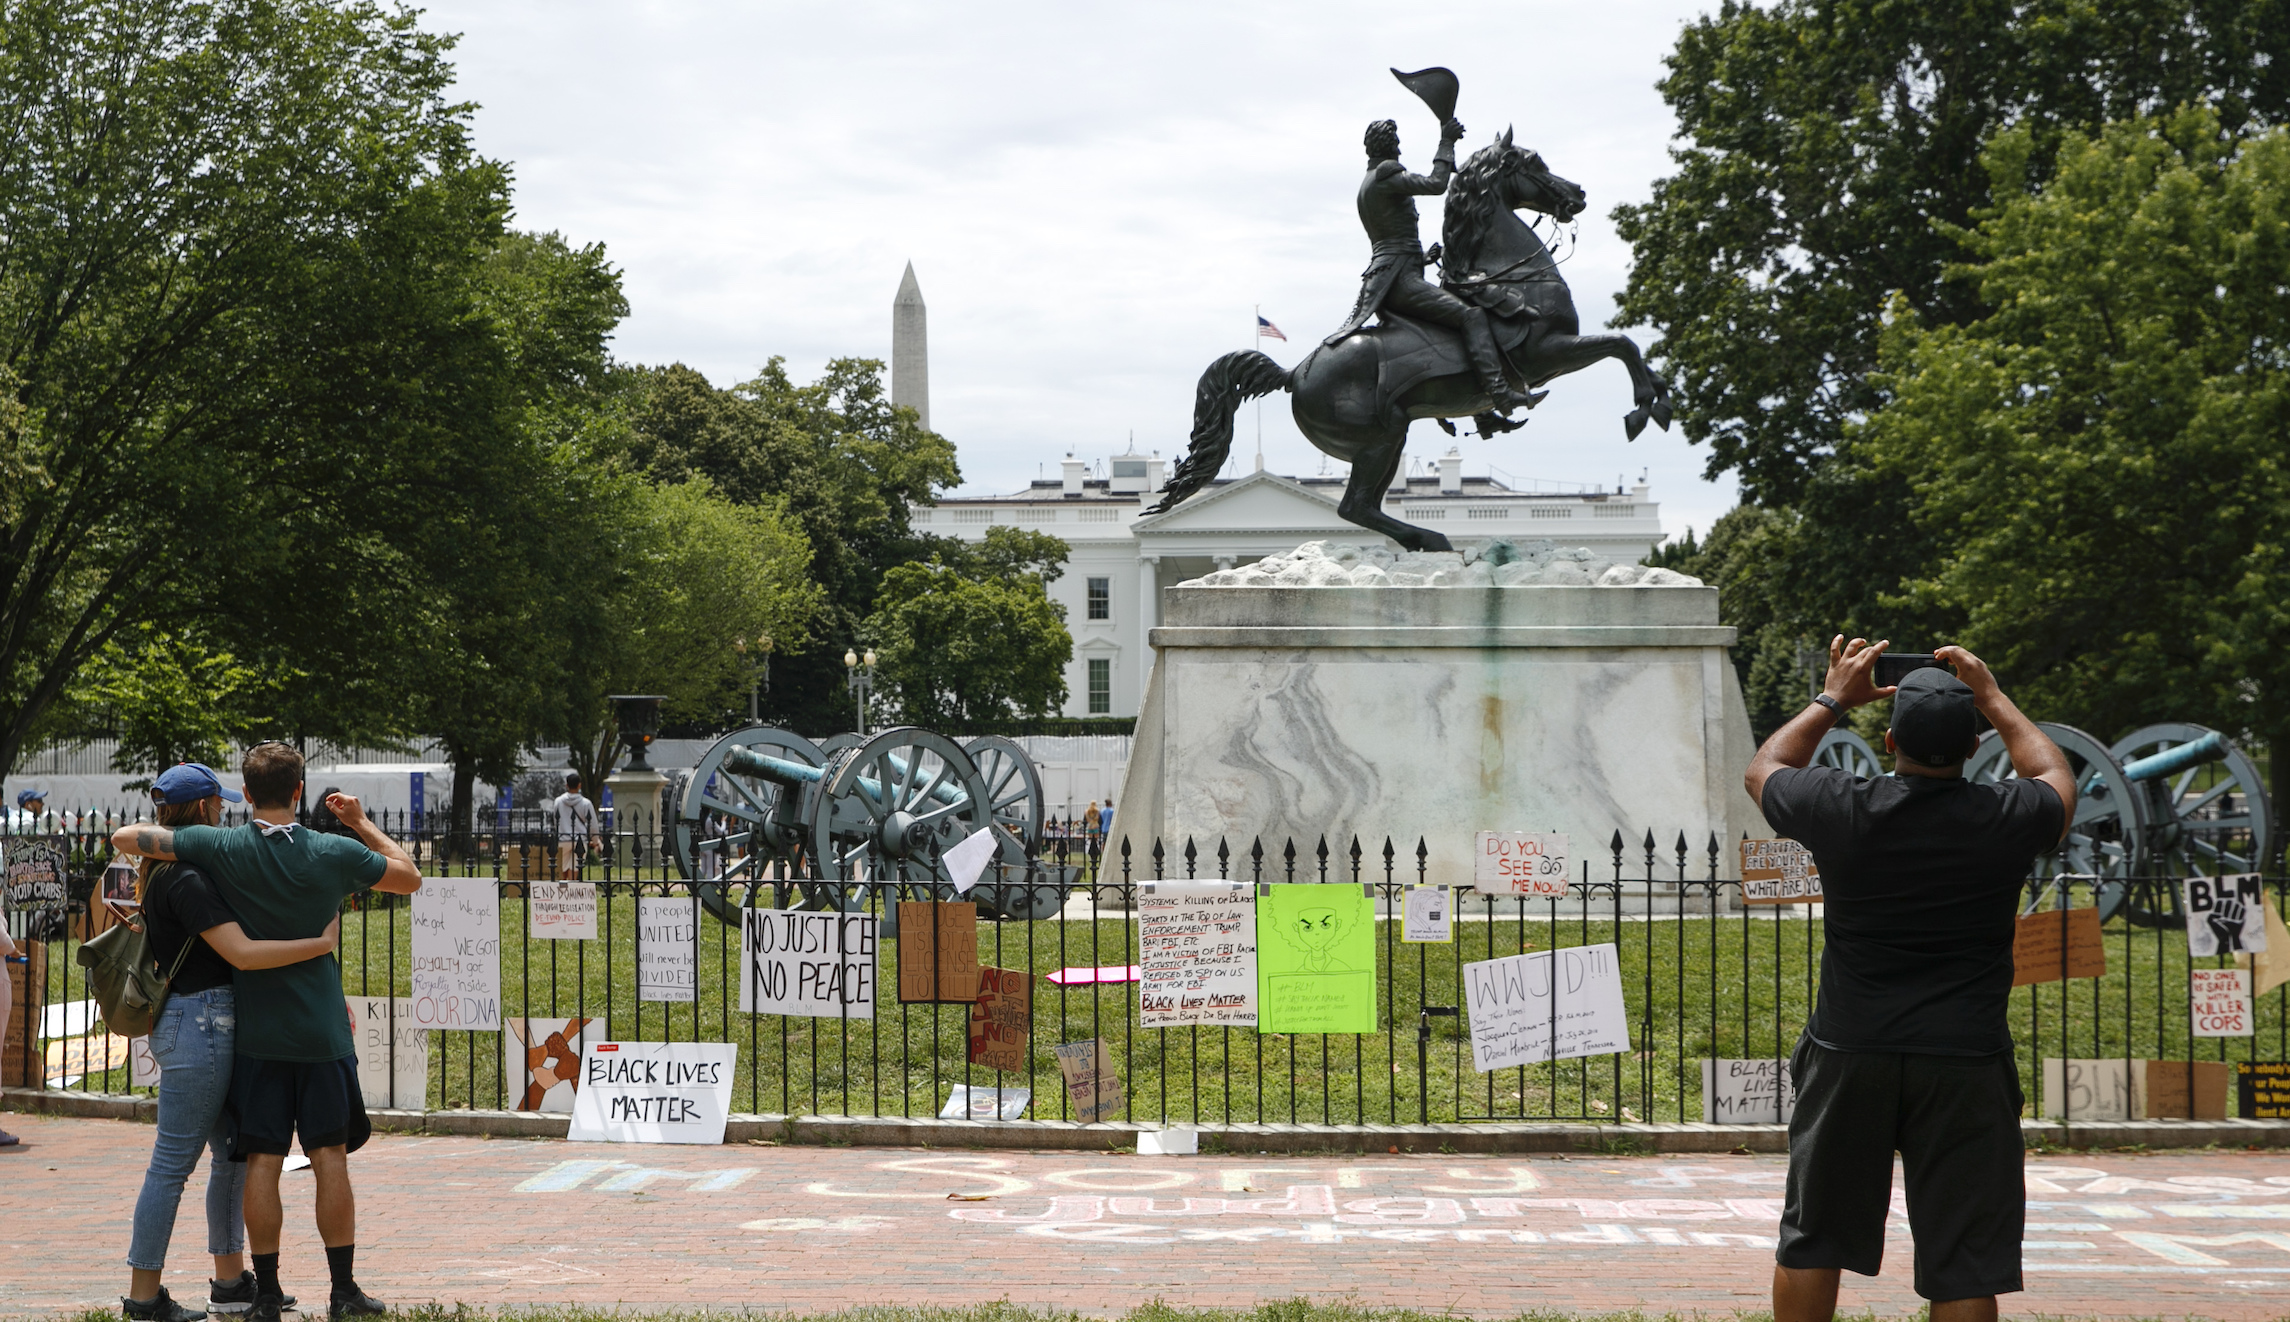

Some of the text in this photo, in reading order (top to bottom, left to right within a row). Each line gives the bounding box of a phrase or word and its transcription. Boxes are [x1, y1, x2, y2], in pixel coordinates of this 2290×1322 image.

[1487, 838, 1544, 856] DO YOU
[1744, 843, 1755, 855] IF
[1498, 858, 1533, 876] SEE
[1746, 854, 1814, 868] ARE YOUR EN
[1782, 867, 1807, 878] THEN
[10, 881, 61, 901] VOID CRABS
[415, 887, 434, 897] We
[532, 886, 596, 900] END DOMINATION
[1512, 879, 1568, 896] ME NOW?
[1745, 877, 1821, 897] WHAT ARE YO
[2190, 875, 2262, 913] BLM
[559, 903, 595, 913] LEGISLATION
[1139, 895, 1179, 906] SYSTEMIC
[1184, 895, 1215, 905] KILLING
[459, 900, 492, 925] We got
[563, 913, 586, 922] POLICE
[640, 905, 693, 919] a people
[900, 904, 965, 928] A BADGE
[1142, 914, 1168, 924] STARTS
[1169, 915, 1178, 923] AT
[1181, 913, 1194, 922] THE
[1212, 912, 1224, 920] OF
[413, 912, 445, 936] We got
[638, 924, 695, 943] UNITED
[746, 912, 878, 955] NO JUSTICE
[913, 931, 971, 951] IS NOT A
[454, 937, 498, 956] WE GOT
[1142, 950, 1151, 960] I
[1152, 951, 1164, 959] AM
[1171, 949, 1199, 957] VICTIM
[1202, 947, 1215, 956] OF
[1217, 944, 1234, 955] FBI
[657, 955, 681, 964] never
[683, 953, 694, 965] be
[905, 951, 975, 974] LICENSE
[1142, 956, 1242, 970] INJUSTICE BECAUSE I
[466, 960, 484, 977] got
[1143, 970, 1181, 980] REFUSED
[1184, 970, 1193, 978] TO
[1195, 969, 1212, 978] SPY
[1215, 969, 1227, 977] ON
[2193, 971, 2235, 981] NO ONE
[638, 970, 695, 985] DIVIDED
[754, 960, 872, 1005] NO PEACE
[979, 968, 1020, 995] NO
[1141, 982, 1162, 991] ARMY
[1166, 981, 1184, 989] FOR
[413, 974, 490, 1003] Royalty inside
[907, 975, 976, 999] TO KILL
[2207, 981, 2241, 993] SAFER
[1142, 993, 1175, 1011] BLACK
[1181, 994, 1205, 1009] LIVES
[2207, 993, 2231, 1001] WITH
[368, 1002, 413, 1020] KILI
[416, 996, 499, 1026] OUR DNA
[788, 1003, 813, 1015] BLM
[1179, 1011, 1200, 1021] BLACK
[2194, 1000, 2245, 1015] KILLER
[2200, 1015, 2243, 1032] COPS
[983, 1022, 1018, 1045] NO
[970, 1035, 1018, 1071] PEACE
[588, 1057, 721, 1086] BLACK LIVES
[1730, 1061, 1791, 1078] BLACK
[2237, 1062, 2290, 1076] Soebody's
[1743, 1079, 1788, 1093] LIVES
[2248, 1077, 2290, 1090] ur Peop
[2254, 1092, 2271, 1103] We
[611, 1095, 701, 1123] MATTER
[2254, 1106, 2278, 1118] ilent
[793, 1156, 1545, 1198] Sorry
[1014, 1220, 1782, 1248] extendin
